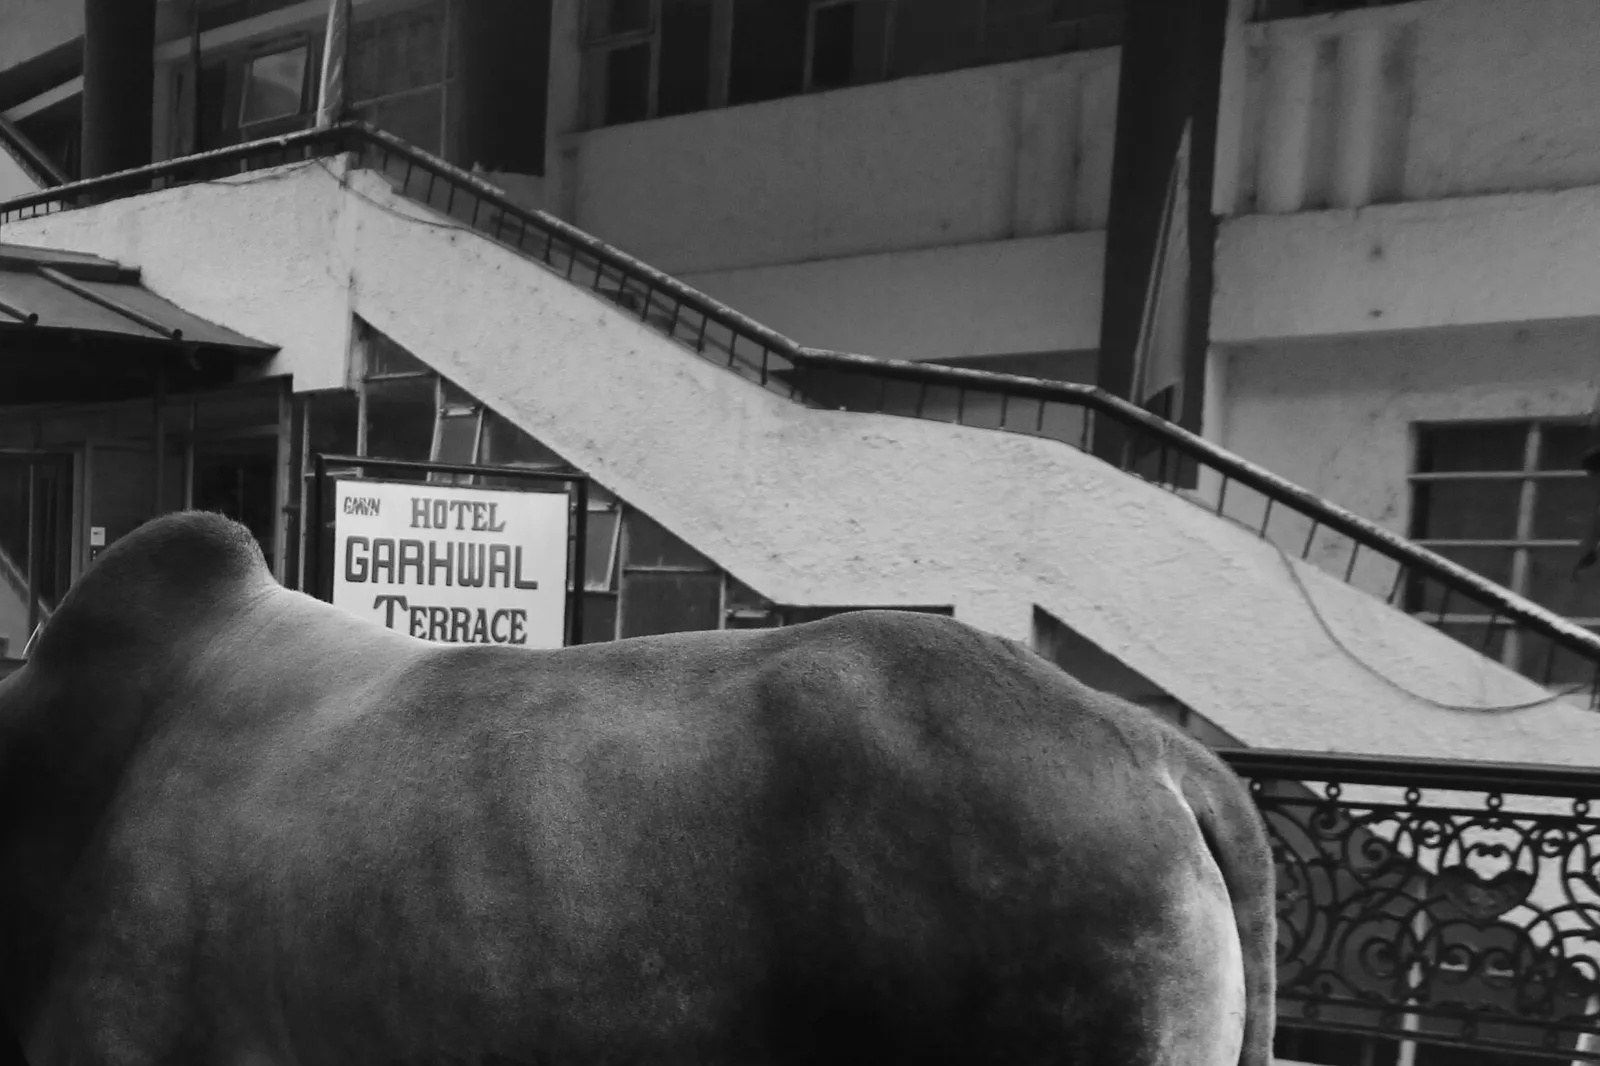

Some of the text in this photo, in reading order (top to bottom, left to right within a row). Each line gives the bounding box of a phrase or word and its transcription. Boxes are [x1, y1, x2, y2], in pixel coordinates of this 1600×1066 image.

[410, 497, 506, 532] HOTEL
[345, 535, 538, 590] GARHWAL
[373, 595, 528, 644] TERRACE
